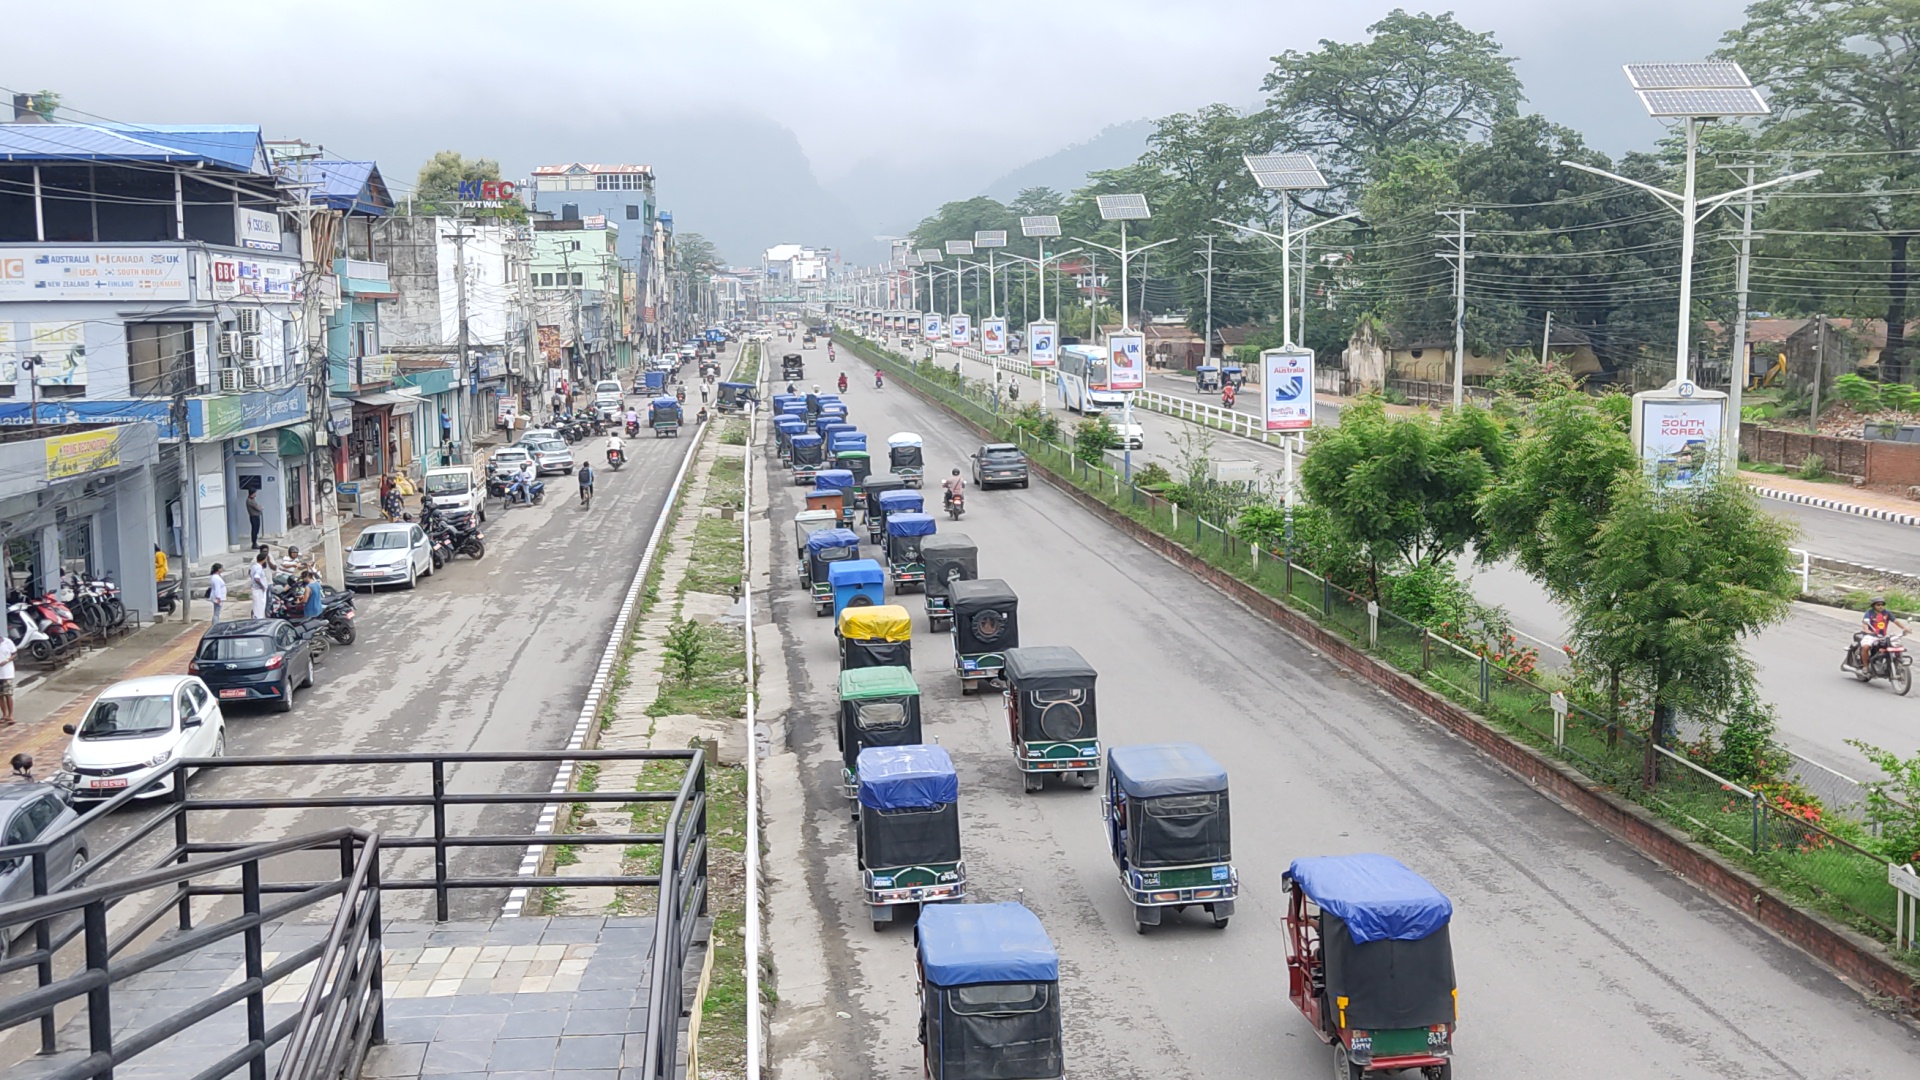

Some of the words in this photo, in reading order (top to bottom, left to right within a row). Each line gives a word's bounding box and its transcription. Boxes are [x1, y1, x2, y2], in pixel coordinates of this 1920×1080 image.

[458, 180, 515, 200] KIEC
[50, 255, 90, 263] AUSTRALIA
[111, 255, 144, 264] CANADA
[166, 255, 179, 263] UK
[217, 264, 235, 280] BBC
[34, 329, 78, 342] IELTS
[1127, 344, 1139, 353] UK
[1680, 385, 1692, 396] 28
[1662, 419, 1705, 427] SOUTH
[1662, 428, 1704, 436] KOREA
